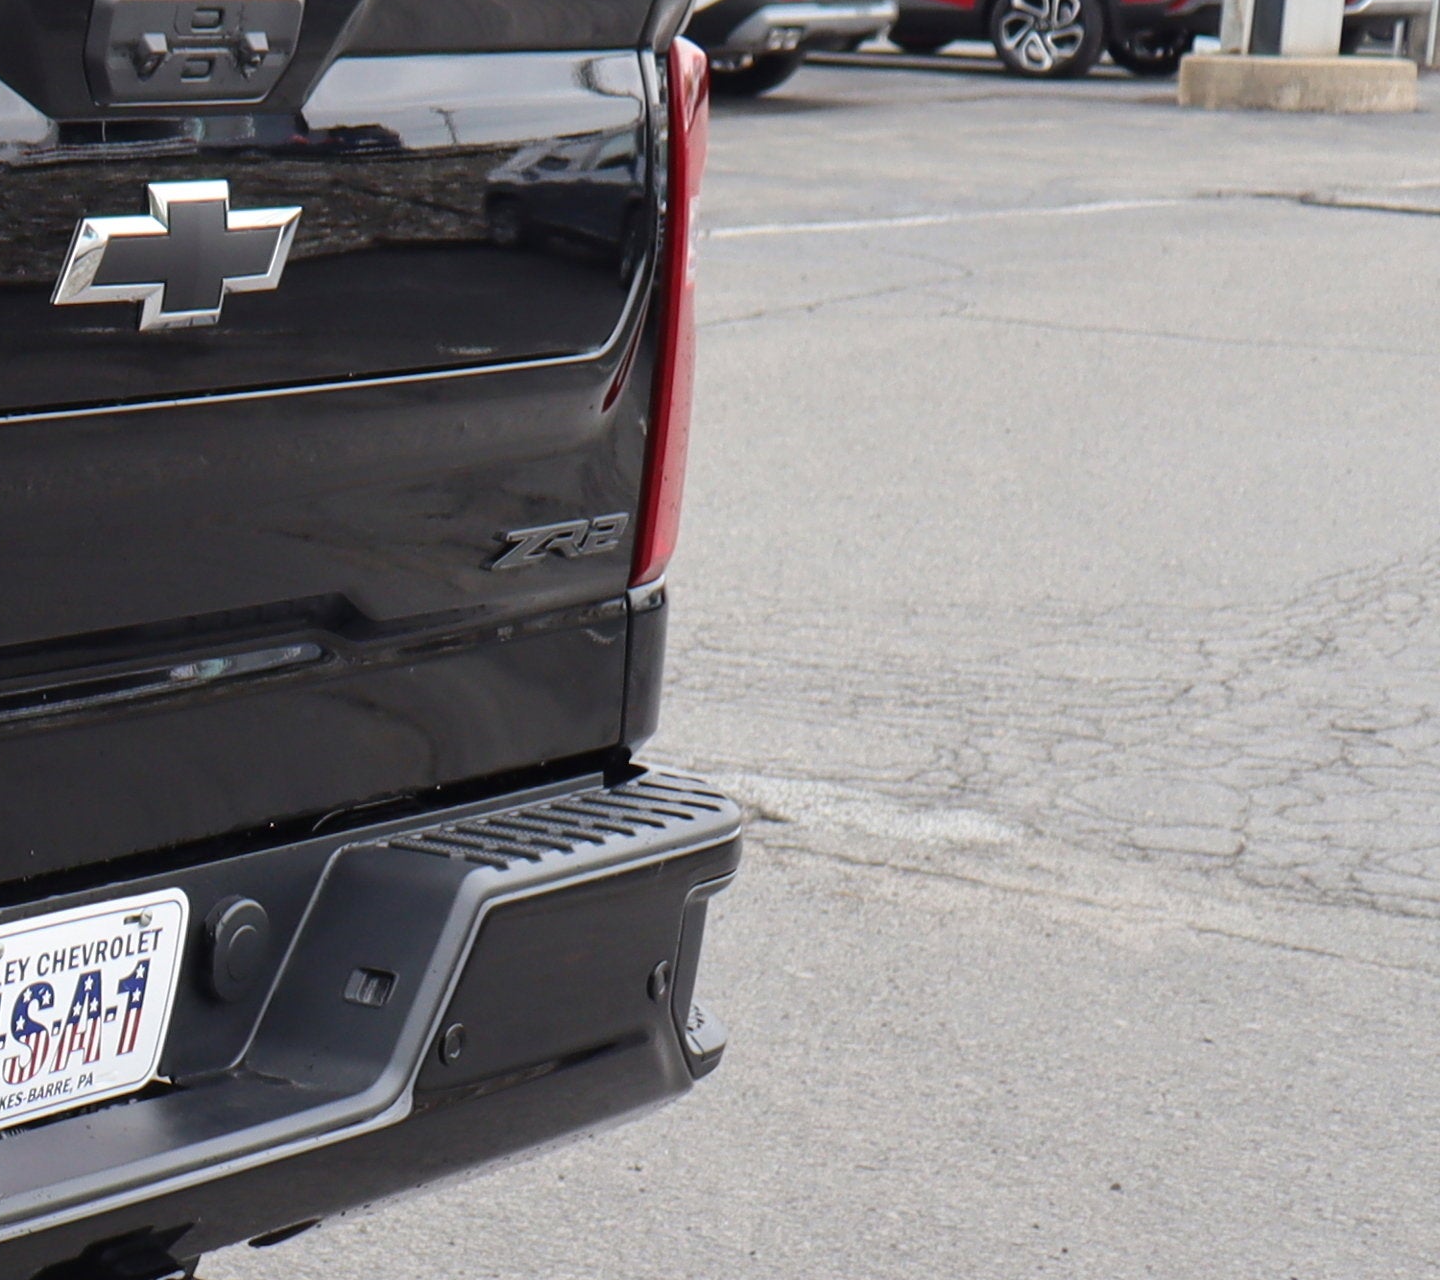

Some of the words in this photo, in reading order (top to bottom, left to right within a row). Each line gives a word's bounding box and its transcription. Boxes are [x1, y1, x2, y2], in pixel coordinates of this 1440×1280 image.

[488, 512, 629, 571] ZR2
[36, 928, 164, 977] CHEVROLET
[76, 1071, 95, 1090] PA
